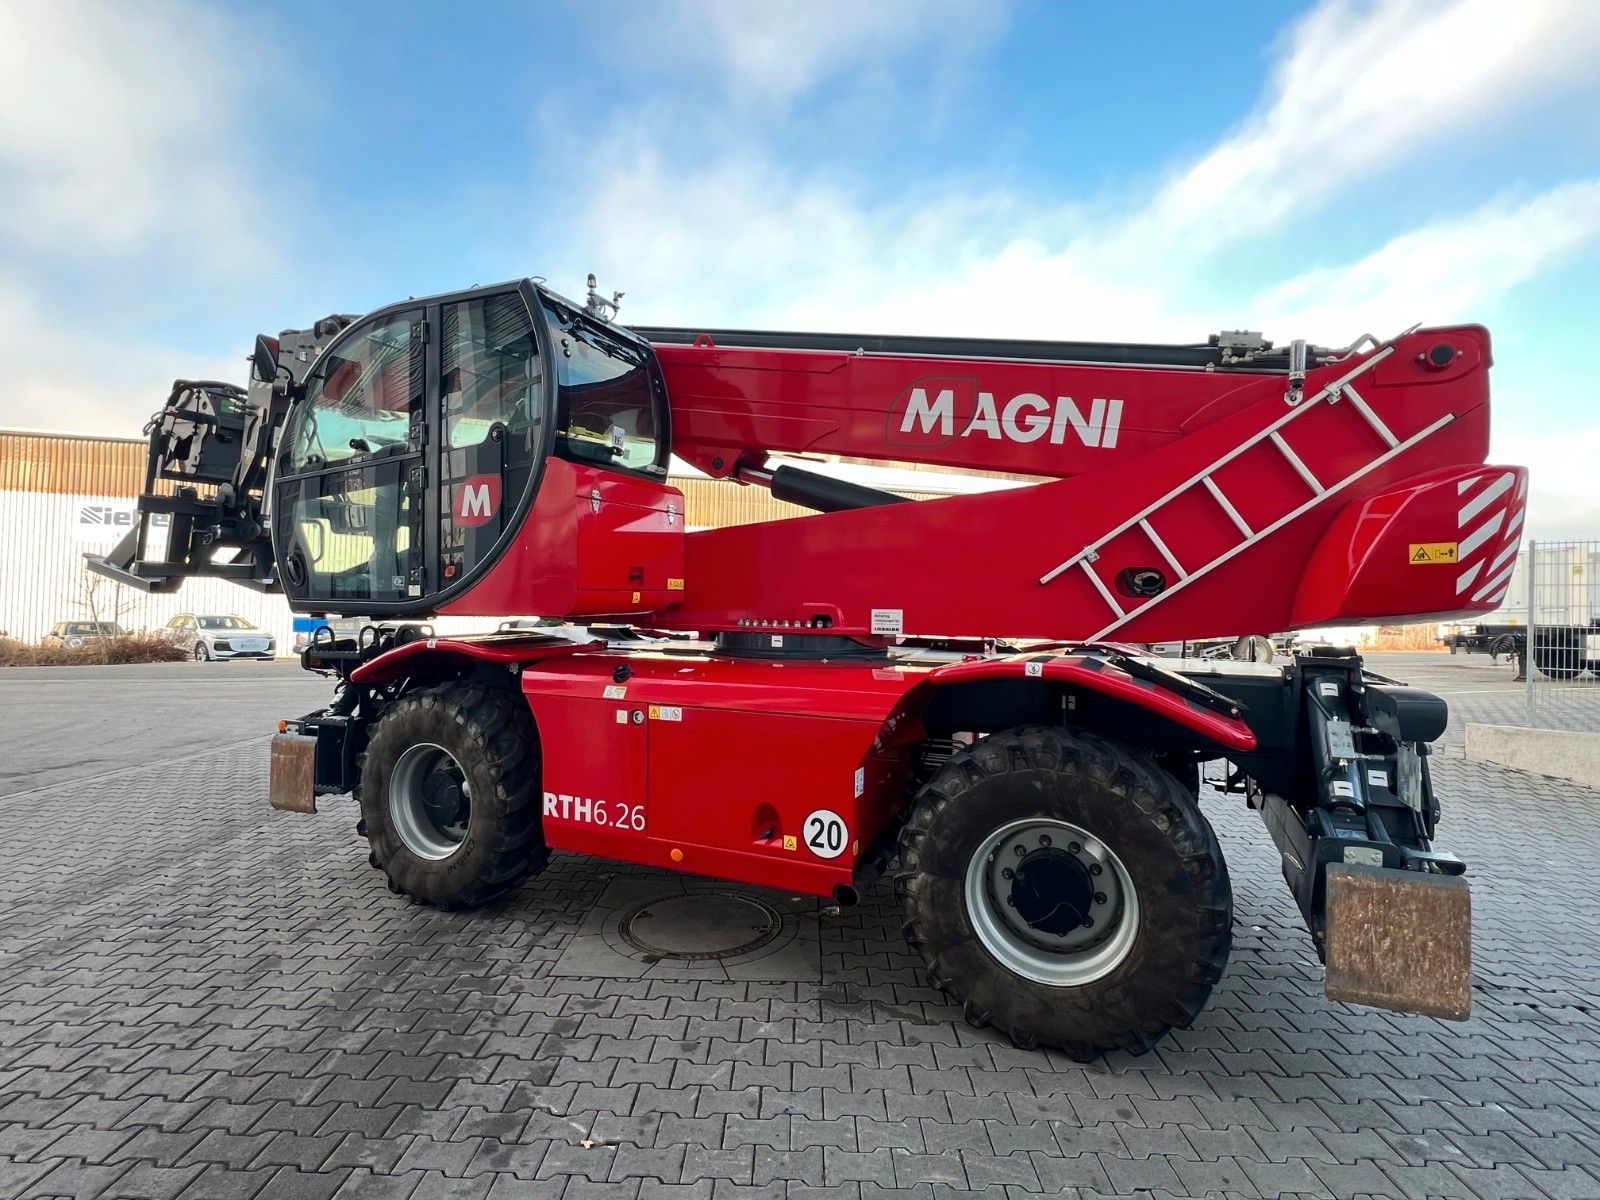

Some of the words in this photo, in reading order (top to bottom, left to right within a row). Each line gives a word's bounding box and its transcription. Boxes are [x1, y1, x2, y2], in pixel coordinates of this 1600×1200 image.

[900, 388, 1124, 448] MAGNI
[461, 484, 491, 517] M
[543, 791, 646, 831] RTH6.26
[809, 817, 842, 851] 20
